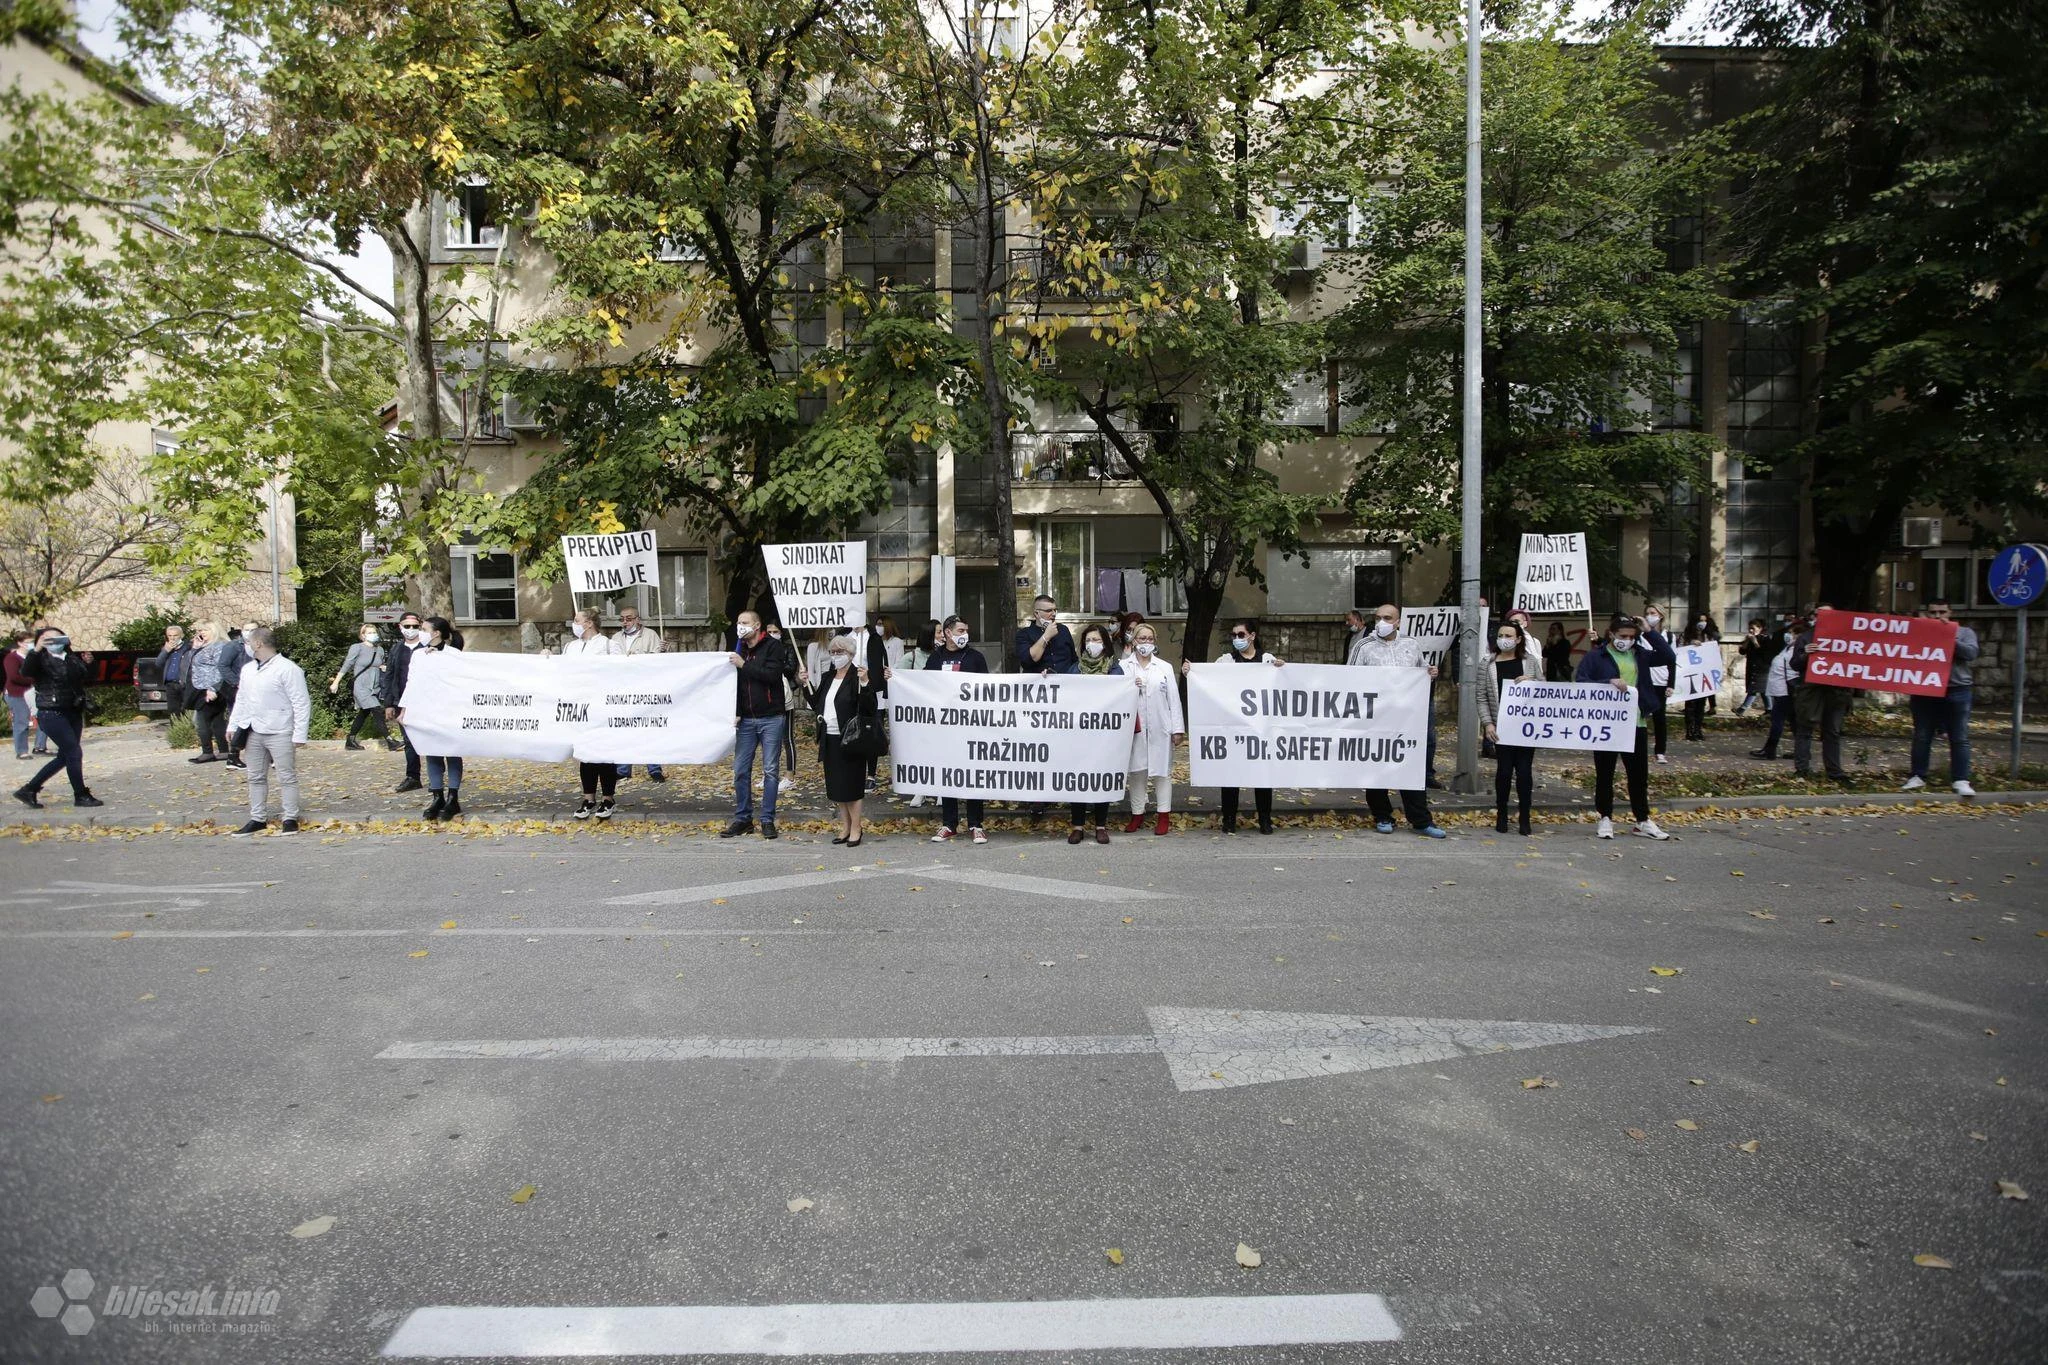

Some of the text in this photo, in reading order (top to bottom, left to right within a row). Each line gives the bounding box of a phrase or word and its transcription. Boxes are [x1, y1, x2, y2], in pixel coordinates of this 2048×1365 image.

[567, 532, 652, 557] PREKIPILO
[1525, 535, 1578, 553] MINISTRE
[782, 545, 845, 565] SINDIKAT
[584, 564, 647, 589] NAM JE
[1526, 564, 1574, 582] IZAĐI IZ
[1518, 592, 1584, 611] BUNKERA
[788, 607, 846, 626] MOSTAR
[1852, 617, 1910, 634] DOM
[1816, 638, 1947, 662] ZDRAVLJA
[1811, 657, 1943, 687] ČAPLJINA
[472, 694, 533, 706] NEZAVISNI SINDIKAT
[606, 694, 673, 705] SINDIKAT ZAPOSLENIKA
[959, 682, 1061, 704] SINDIKAT
[1508, 686, 1631, 702] DOM ZDRAVLJA KONJIC
[556, 698, 590, 722] ŠTRAJK
[1240, 689, 1379, 719] SINDIKAT
[1507, 703, 1628, 721] OPĆA BOLNICA KONJIC
[462, 717, 540, 731] ZAPOSLENIKA SKB MOSTAR
[608, 717, 613, 727] U
[614, 717, 649, 728] ZDRAVSTVU
[895, 705, 936, 725] DOMA
[940, 708, 1017, 728] ZDRAVLJA
[1522, 722, 1553, 740] 0,5
[1579, 725, 1611, 743] 0,5
[967, 738, 1049, 762] TRAŽIMO
[1200, 736, 1227, 760] KB
[1276, 736, 1332, 761] SAFET
[896, 764, 1125, 792] NOVI KOLEKTIVNI UGOVOR
